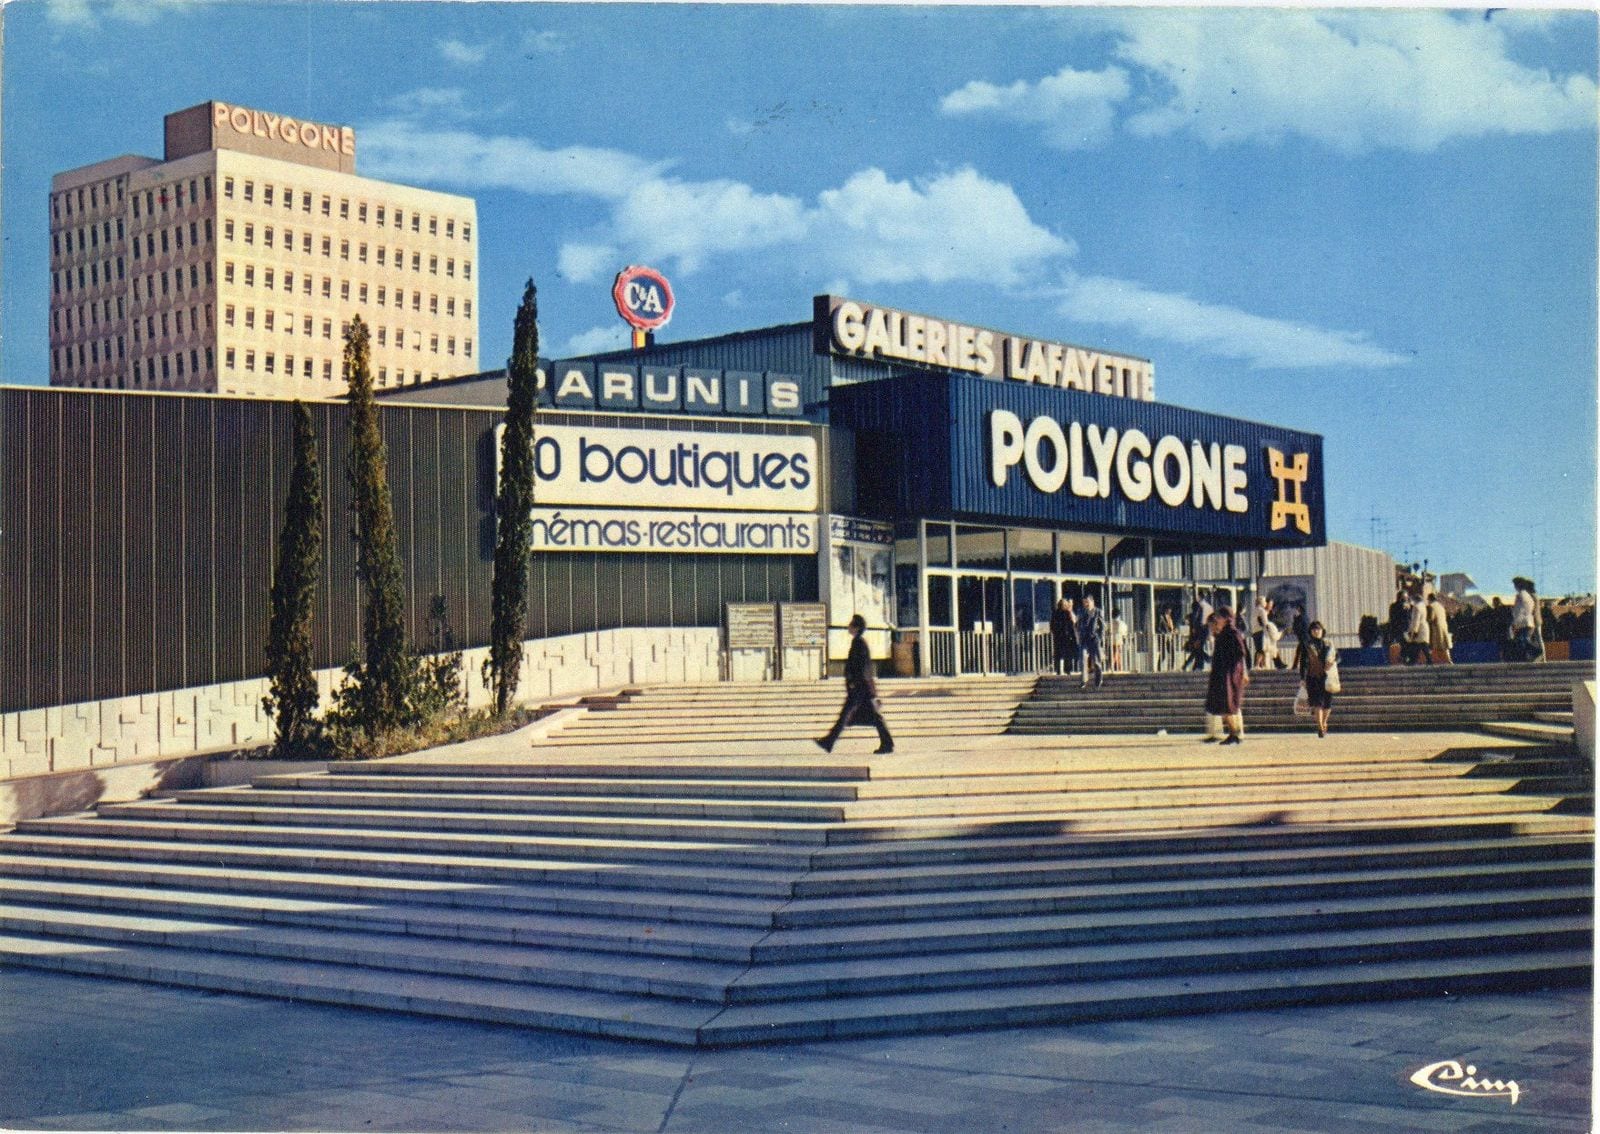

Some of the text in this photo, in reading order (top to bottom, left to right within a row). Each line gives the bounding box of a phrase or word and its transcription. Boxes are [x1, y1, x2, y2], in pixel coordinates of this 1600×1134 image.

[213, 102, 355, 156] POLYGONE
[623, 282, 664, 313] C&A
[834, 302, 1155, 402] GALERIES LAFAYETTE
[535, 368, 800, 409] ARUNIS
[534, 436, 811, 496] 0 boutiques
[990, 409, 1249, 514] POLYGONE
